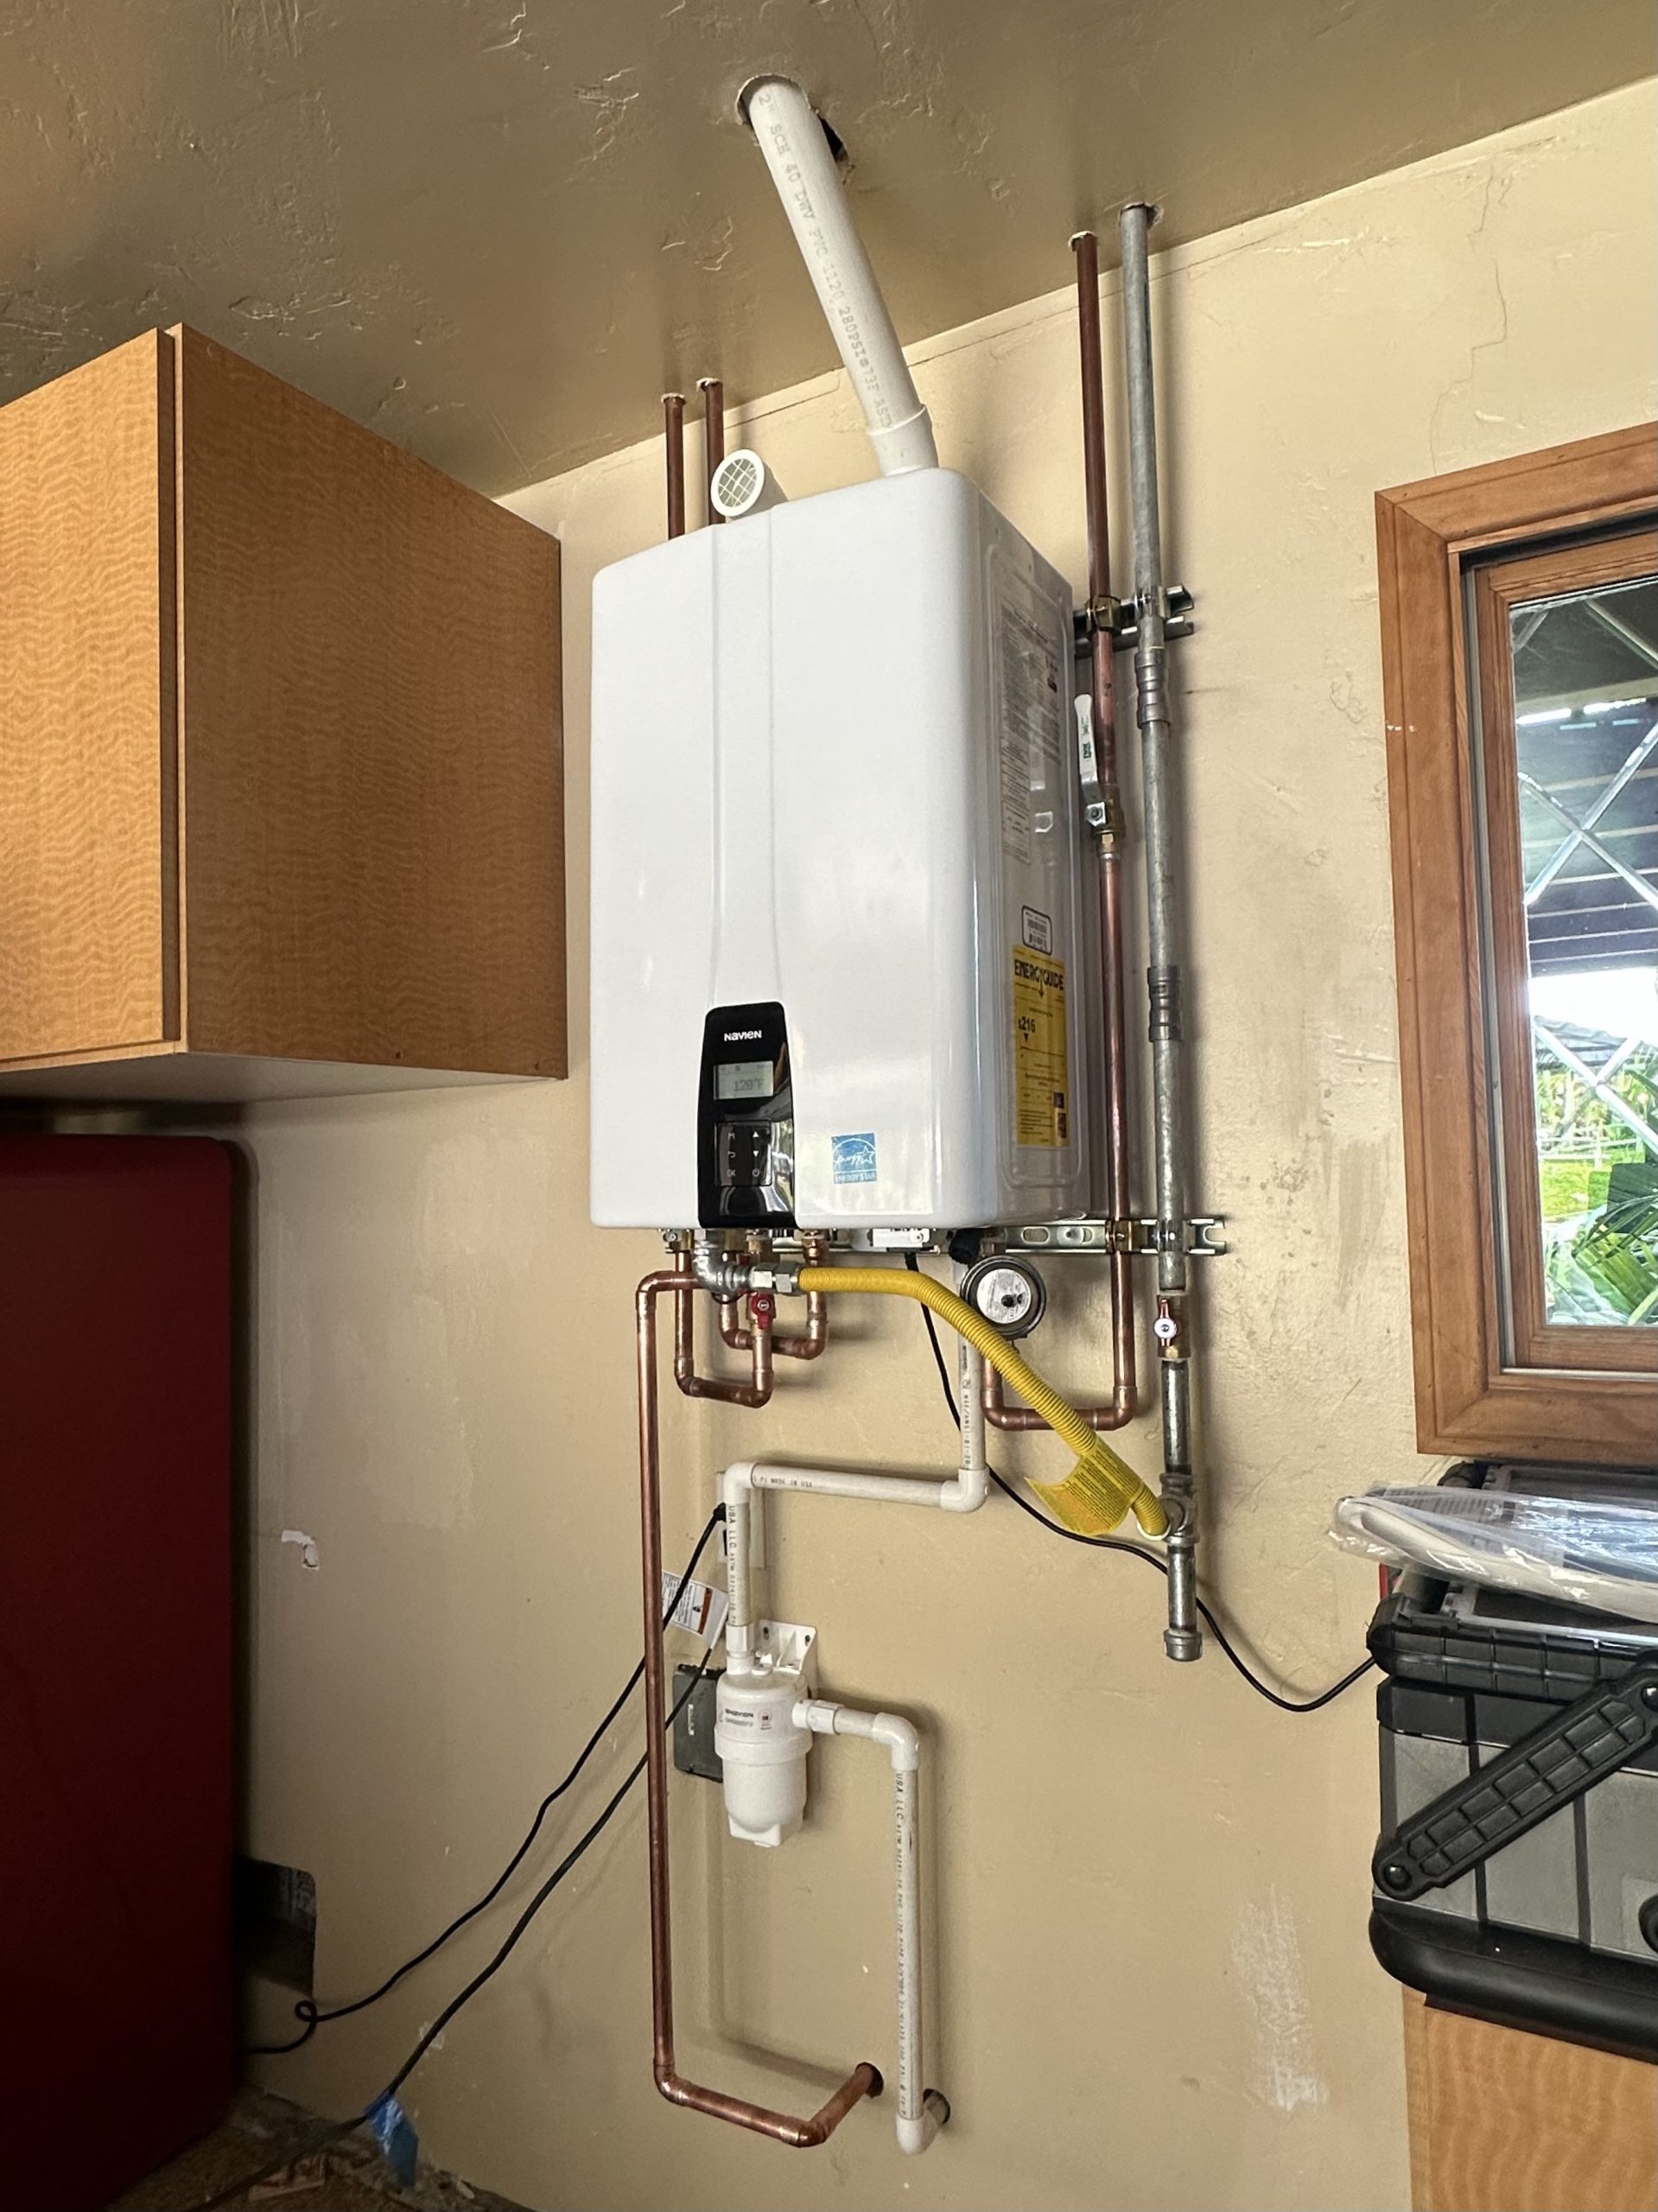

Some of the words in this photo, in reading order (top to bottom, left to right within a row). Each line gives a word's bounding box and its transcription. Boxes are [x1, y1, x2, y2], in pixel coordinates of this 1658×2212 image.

[770, 124, 791, 156] SCH
[785, 163, 801, 183] 40
[795, 189, 816, 219] DWV
[809, 228, 829, 257] PVC
[727, 1132, 736, 1141] M
[727, 1505, 736, 1523] USA
[728, 1529, 737, 1548] LLC
[895, 1772, 904, 1793] USA
[895, 1799, 905, 1821] LLC
